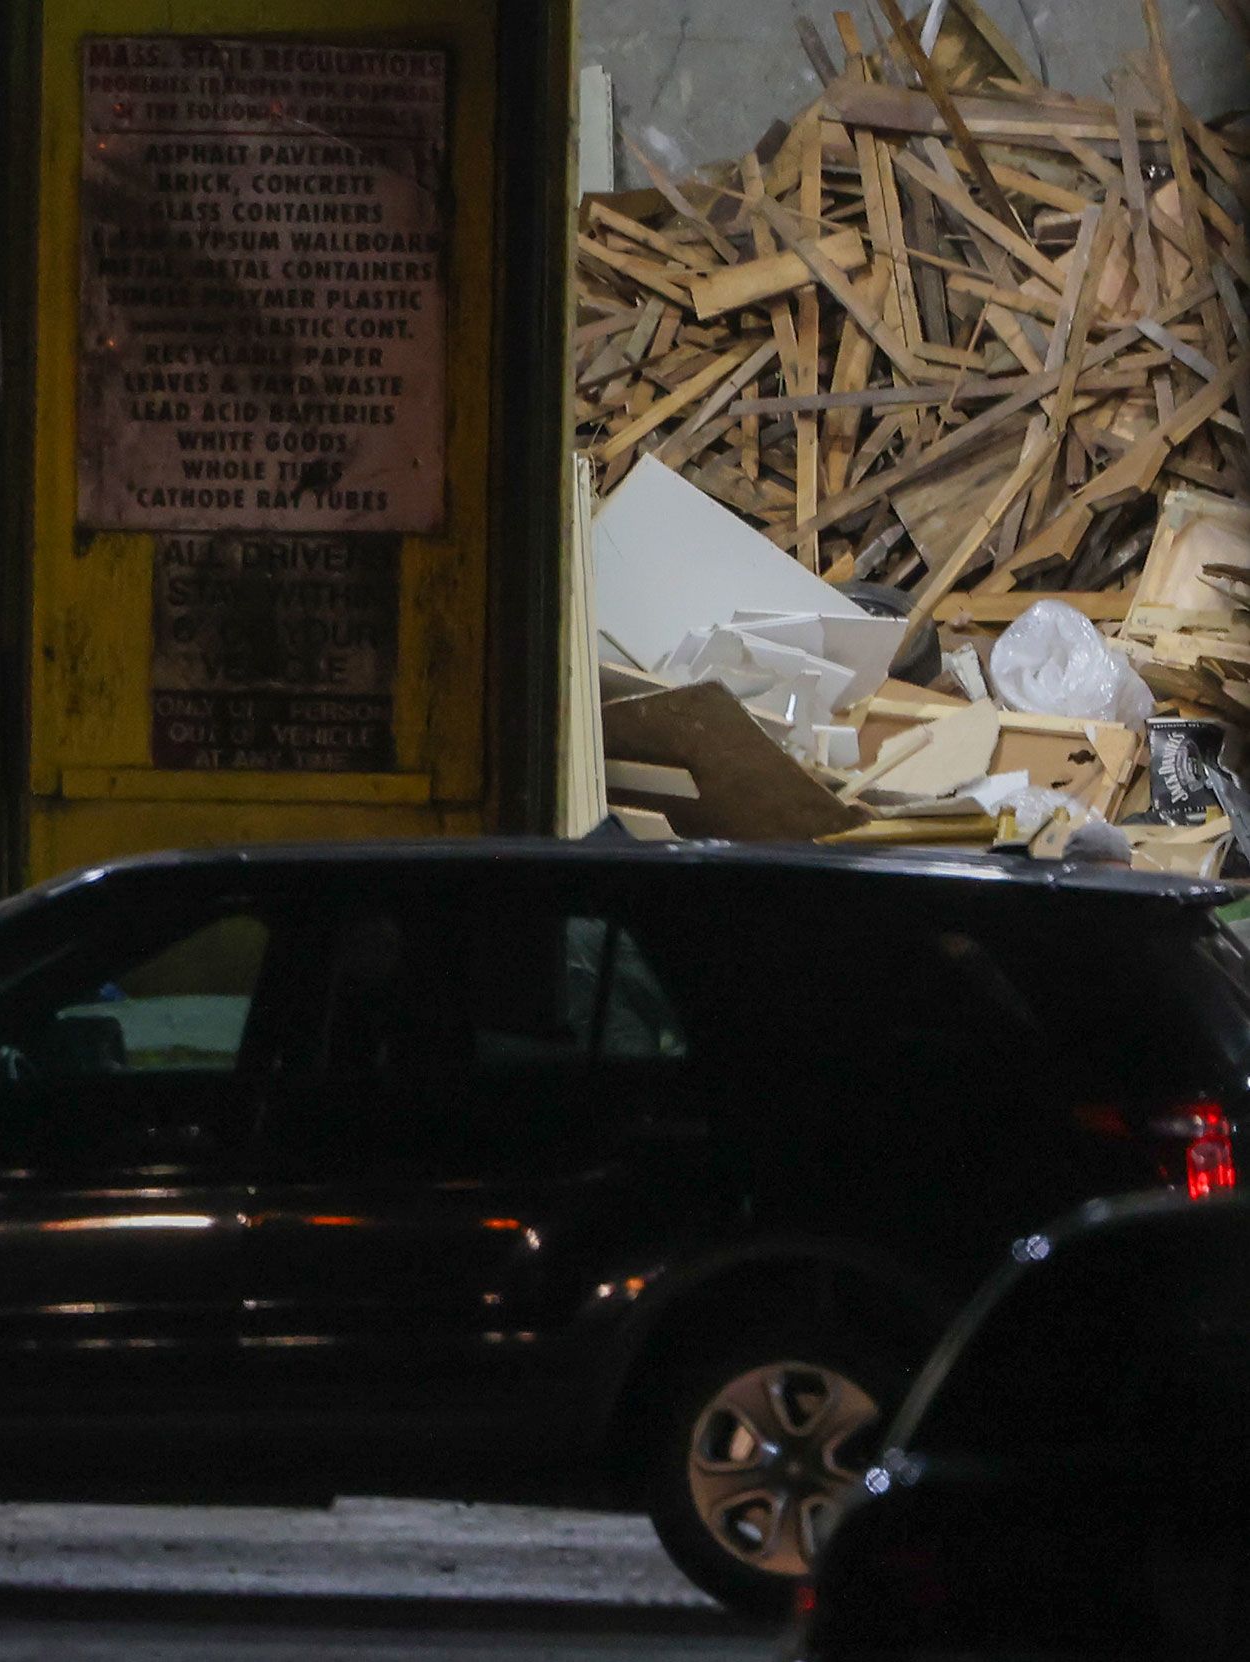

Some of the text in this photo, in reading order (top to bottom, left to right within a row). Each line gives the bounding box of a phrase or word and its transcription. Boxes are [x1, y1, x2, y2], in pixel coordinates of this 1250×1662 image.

[146, 144, 388, 166] ASPHALT PAVEMENT
[158, 173, 374, 197] BRICK, CONCRETE
[149, 202, 382, 223] GLASS CONTAINERS
[179, 231, 279, 251] GYPSUM
[282, 261, 432, 282] CONTAINERS
[328, 289, 422, 310] PLASTIC
[239, 318, 334, 338] PLASTIC
[346, 319, 414, 339] CONT.
[306, 347, 382, 367] PAPER
[125, 373, 403, 397] LEAVES & YARD WASTE
[131, 402, 396, 426] LEAD ACID BATTERIES
[178, 431, 347, 453] WHITE GOODS
[182, 460, 265, 480] WHOLE
[137, 489, 387, 511] CATHODE RAY TUBES
[1164, 773, 1189, 804] JACK
